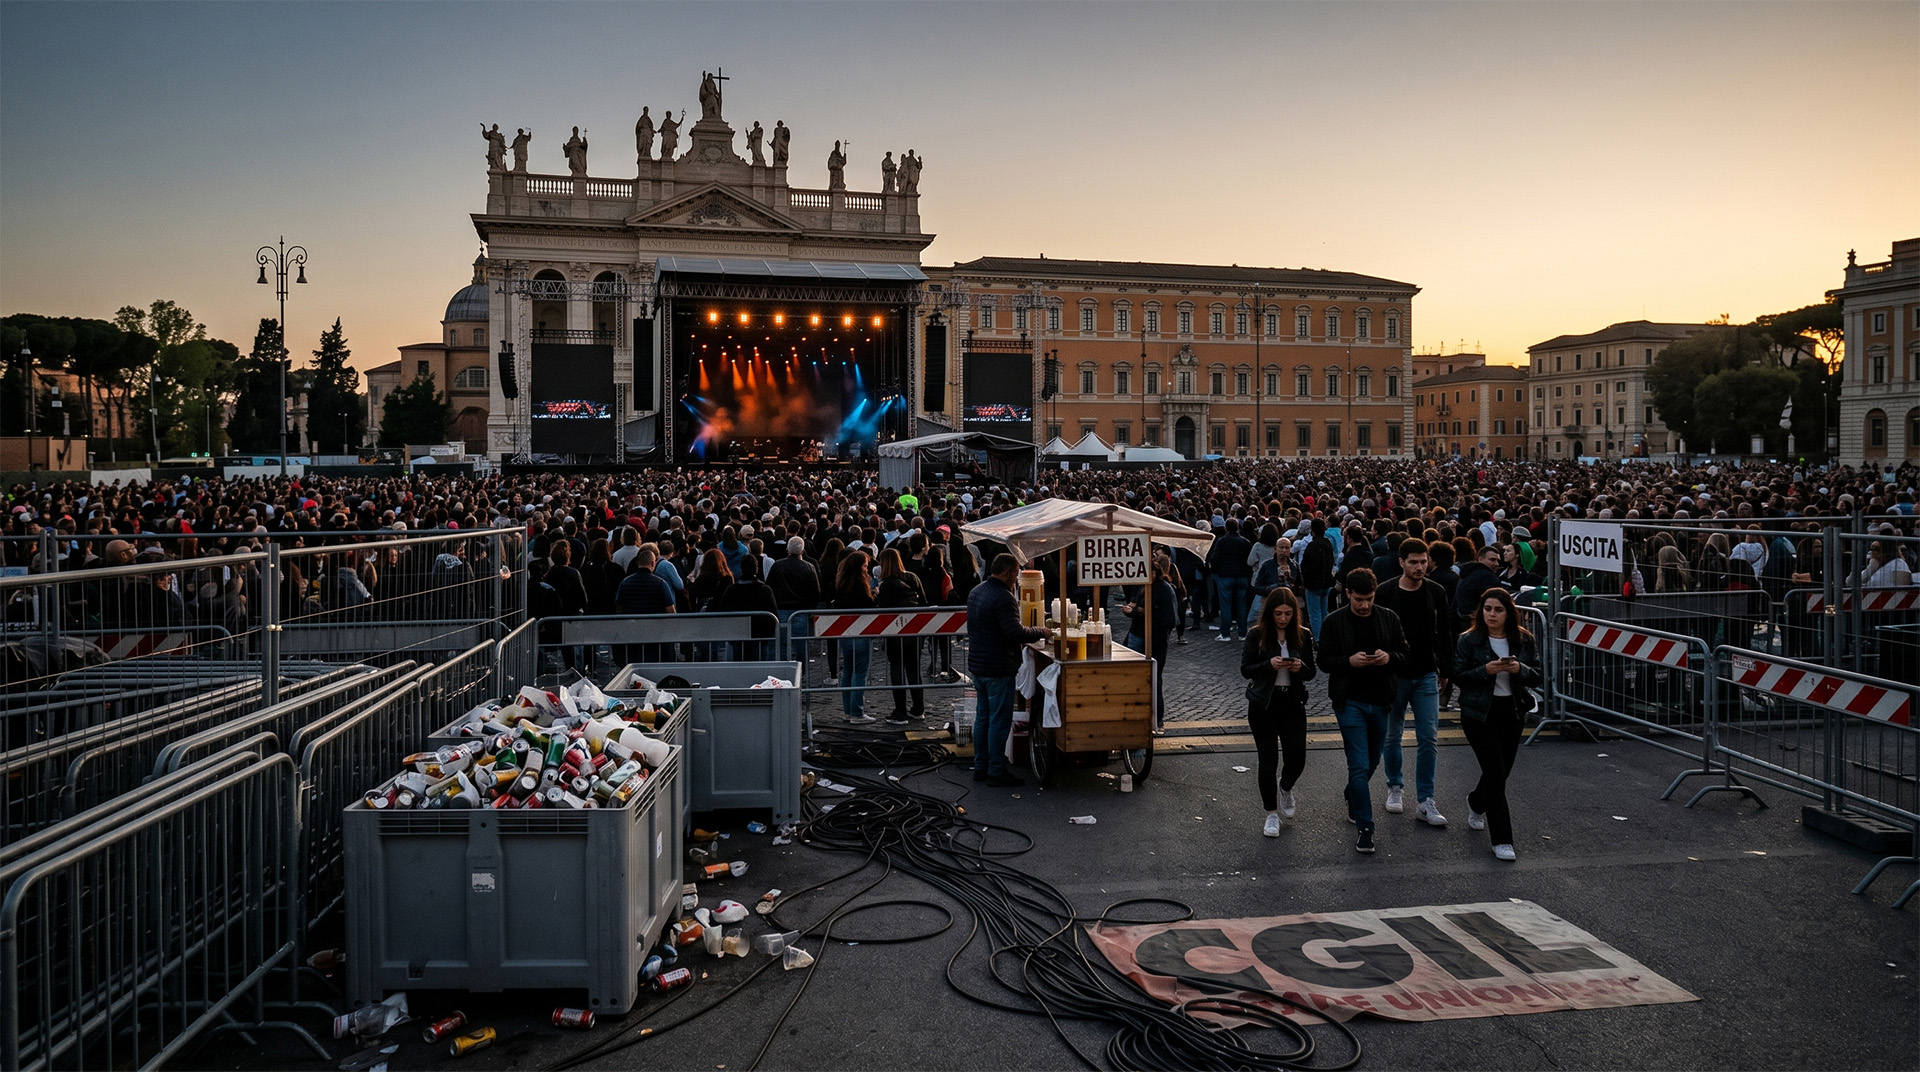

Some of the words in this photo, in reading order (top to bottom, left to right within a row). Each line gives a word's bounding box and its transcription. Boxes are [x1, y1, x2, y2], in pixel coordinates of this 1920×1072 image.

[1084, 538, 1144, 558] BIRRA
[1562, 534, 1619, 560] USCITA
[1081, 561, 1147, 579] FRESCA
[1135, 911, 1619, 994] CGIL
[1381, 983, 1557, 1012] UNION
